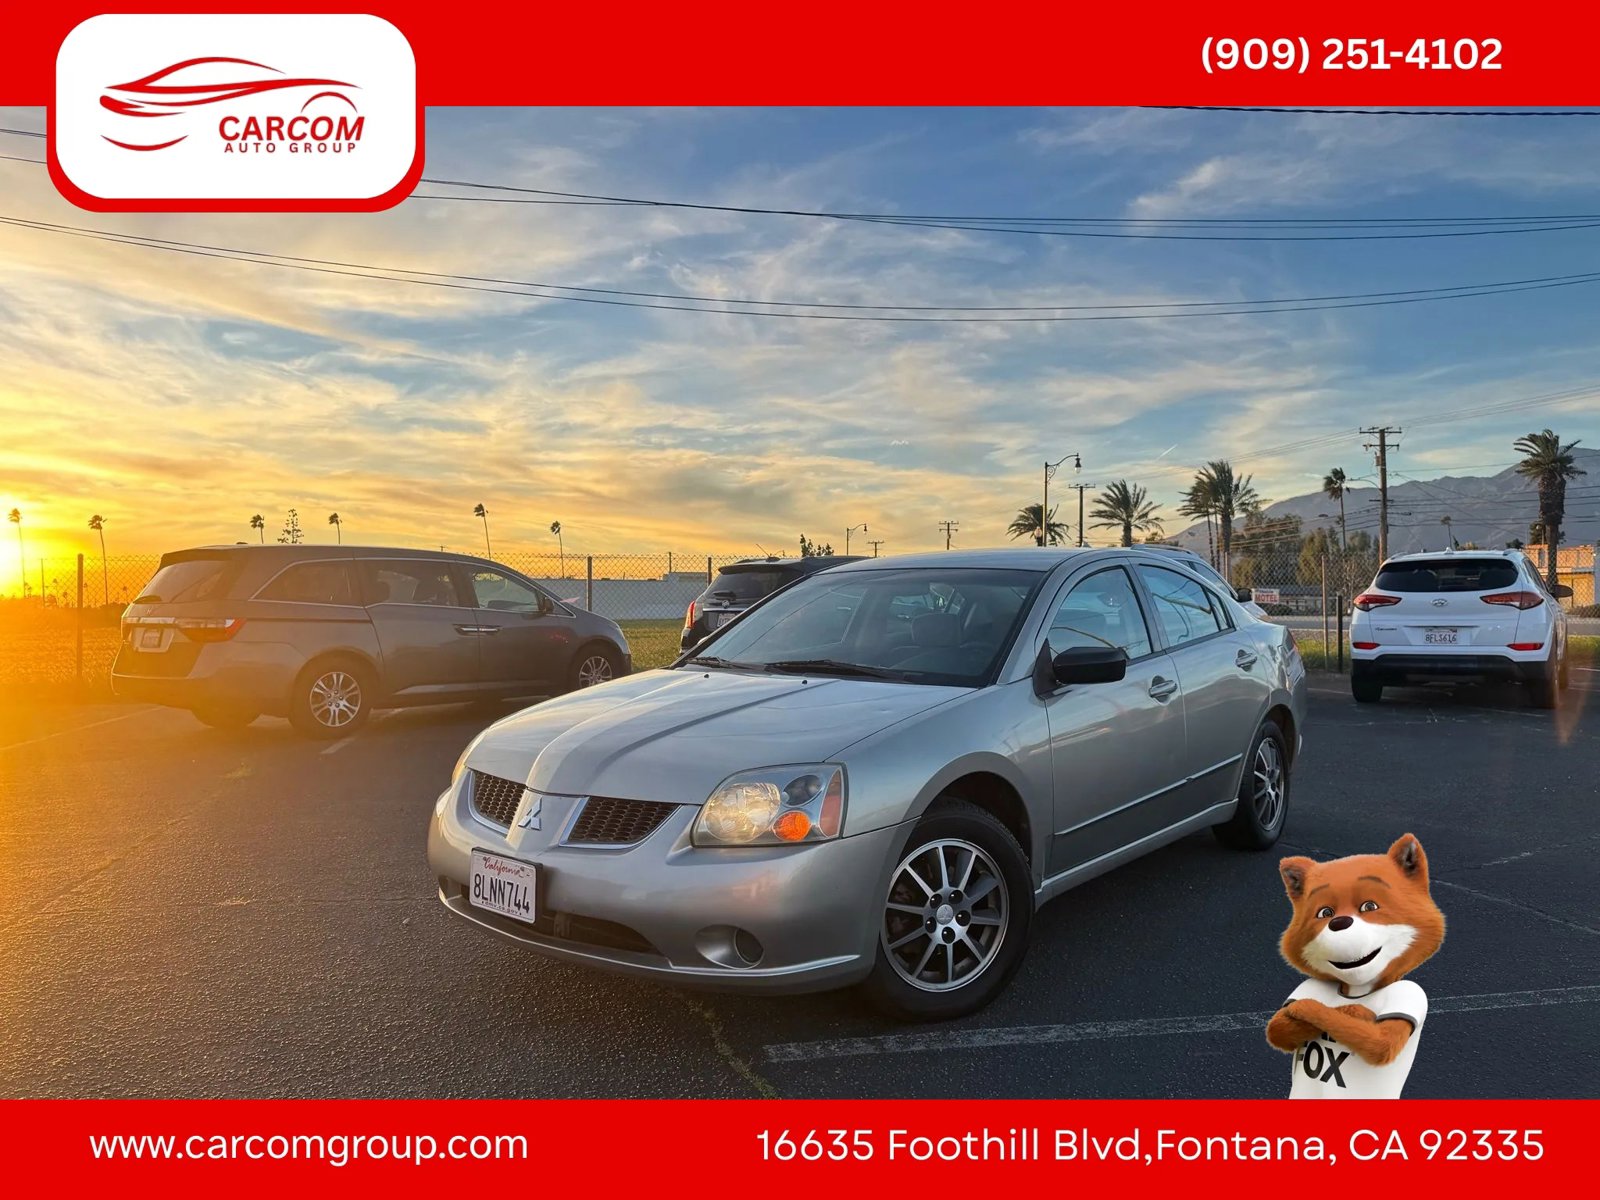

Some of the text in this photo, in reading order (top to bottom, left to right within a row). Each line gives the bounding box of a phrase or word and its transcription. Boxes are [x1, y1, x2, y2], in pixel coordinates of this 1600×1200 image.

[1255, 594, 1279, 602] MOTEL
[483, 857, 523, 877] California
[473, 873, 530, 913] 8LNN744
